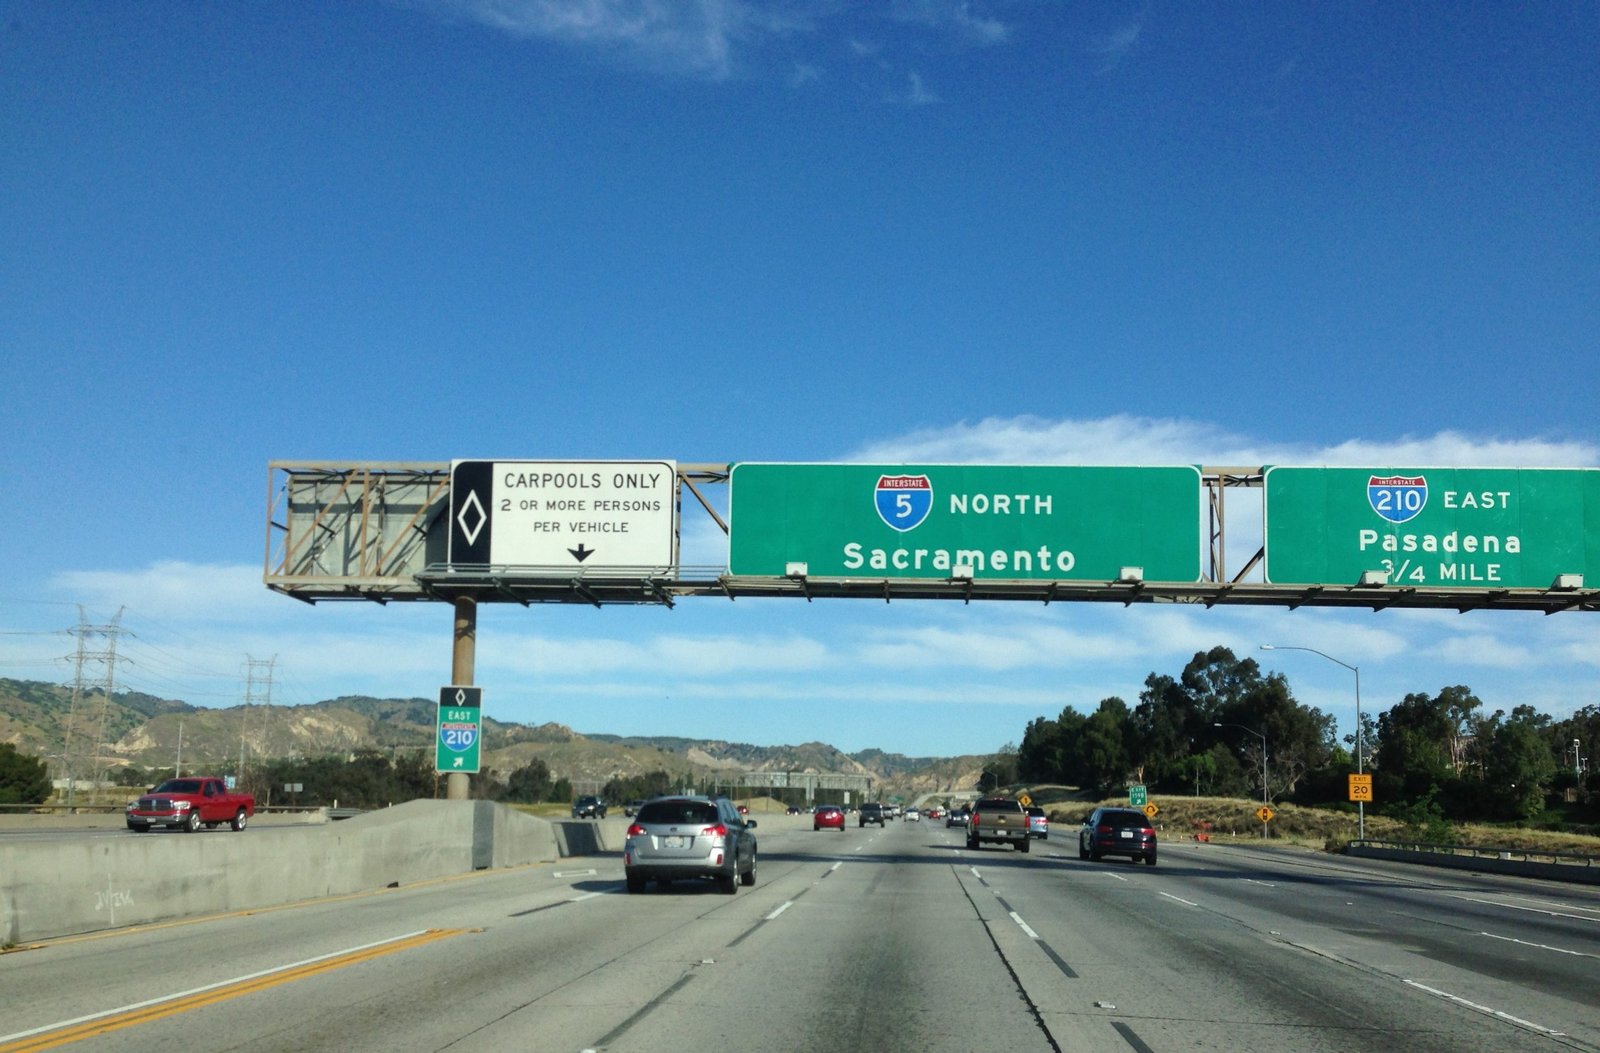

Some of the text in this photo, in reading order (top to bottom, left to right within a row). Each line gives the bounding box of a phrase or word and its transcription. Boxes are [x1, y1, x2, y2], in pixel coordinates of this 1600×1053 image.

[504, 472, 661, 489] CARPOOLS ONLY
[883, 480, 924, 488] INTERSTATE
[501, 499, 661, 512] 2 OR MORE PERSONS
[896, 494, 912, 519] 5
[950, 494, 1052, 515] NORTH
[1376, 489, 1421, 511] 210
[1443, 491, 1511, 509] EAST
[533, 522, 629, 533] PER VEHICLE
[1359, 529, 1521, 554] Pasadena
[843, 542, 1076, 572] Sacramento
[1380, 559, 1501, 584] 3/4 MILE
[448, 710, 471, 720] EAST
[446, 730, 473, 745] 210
[1354, 786, 1368, 794] 20
